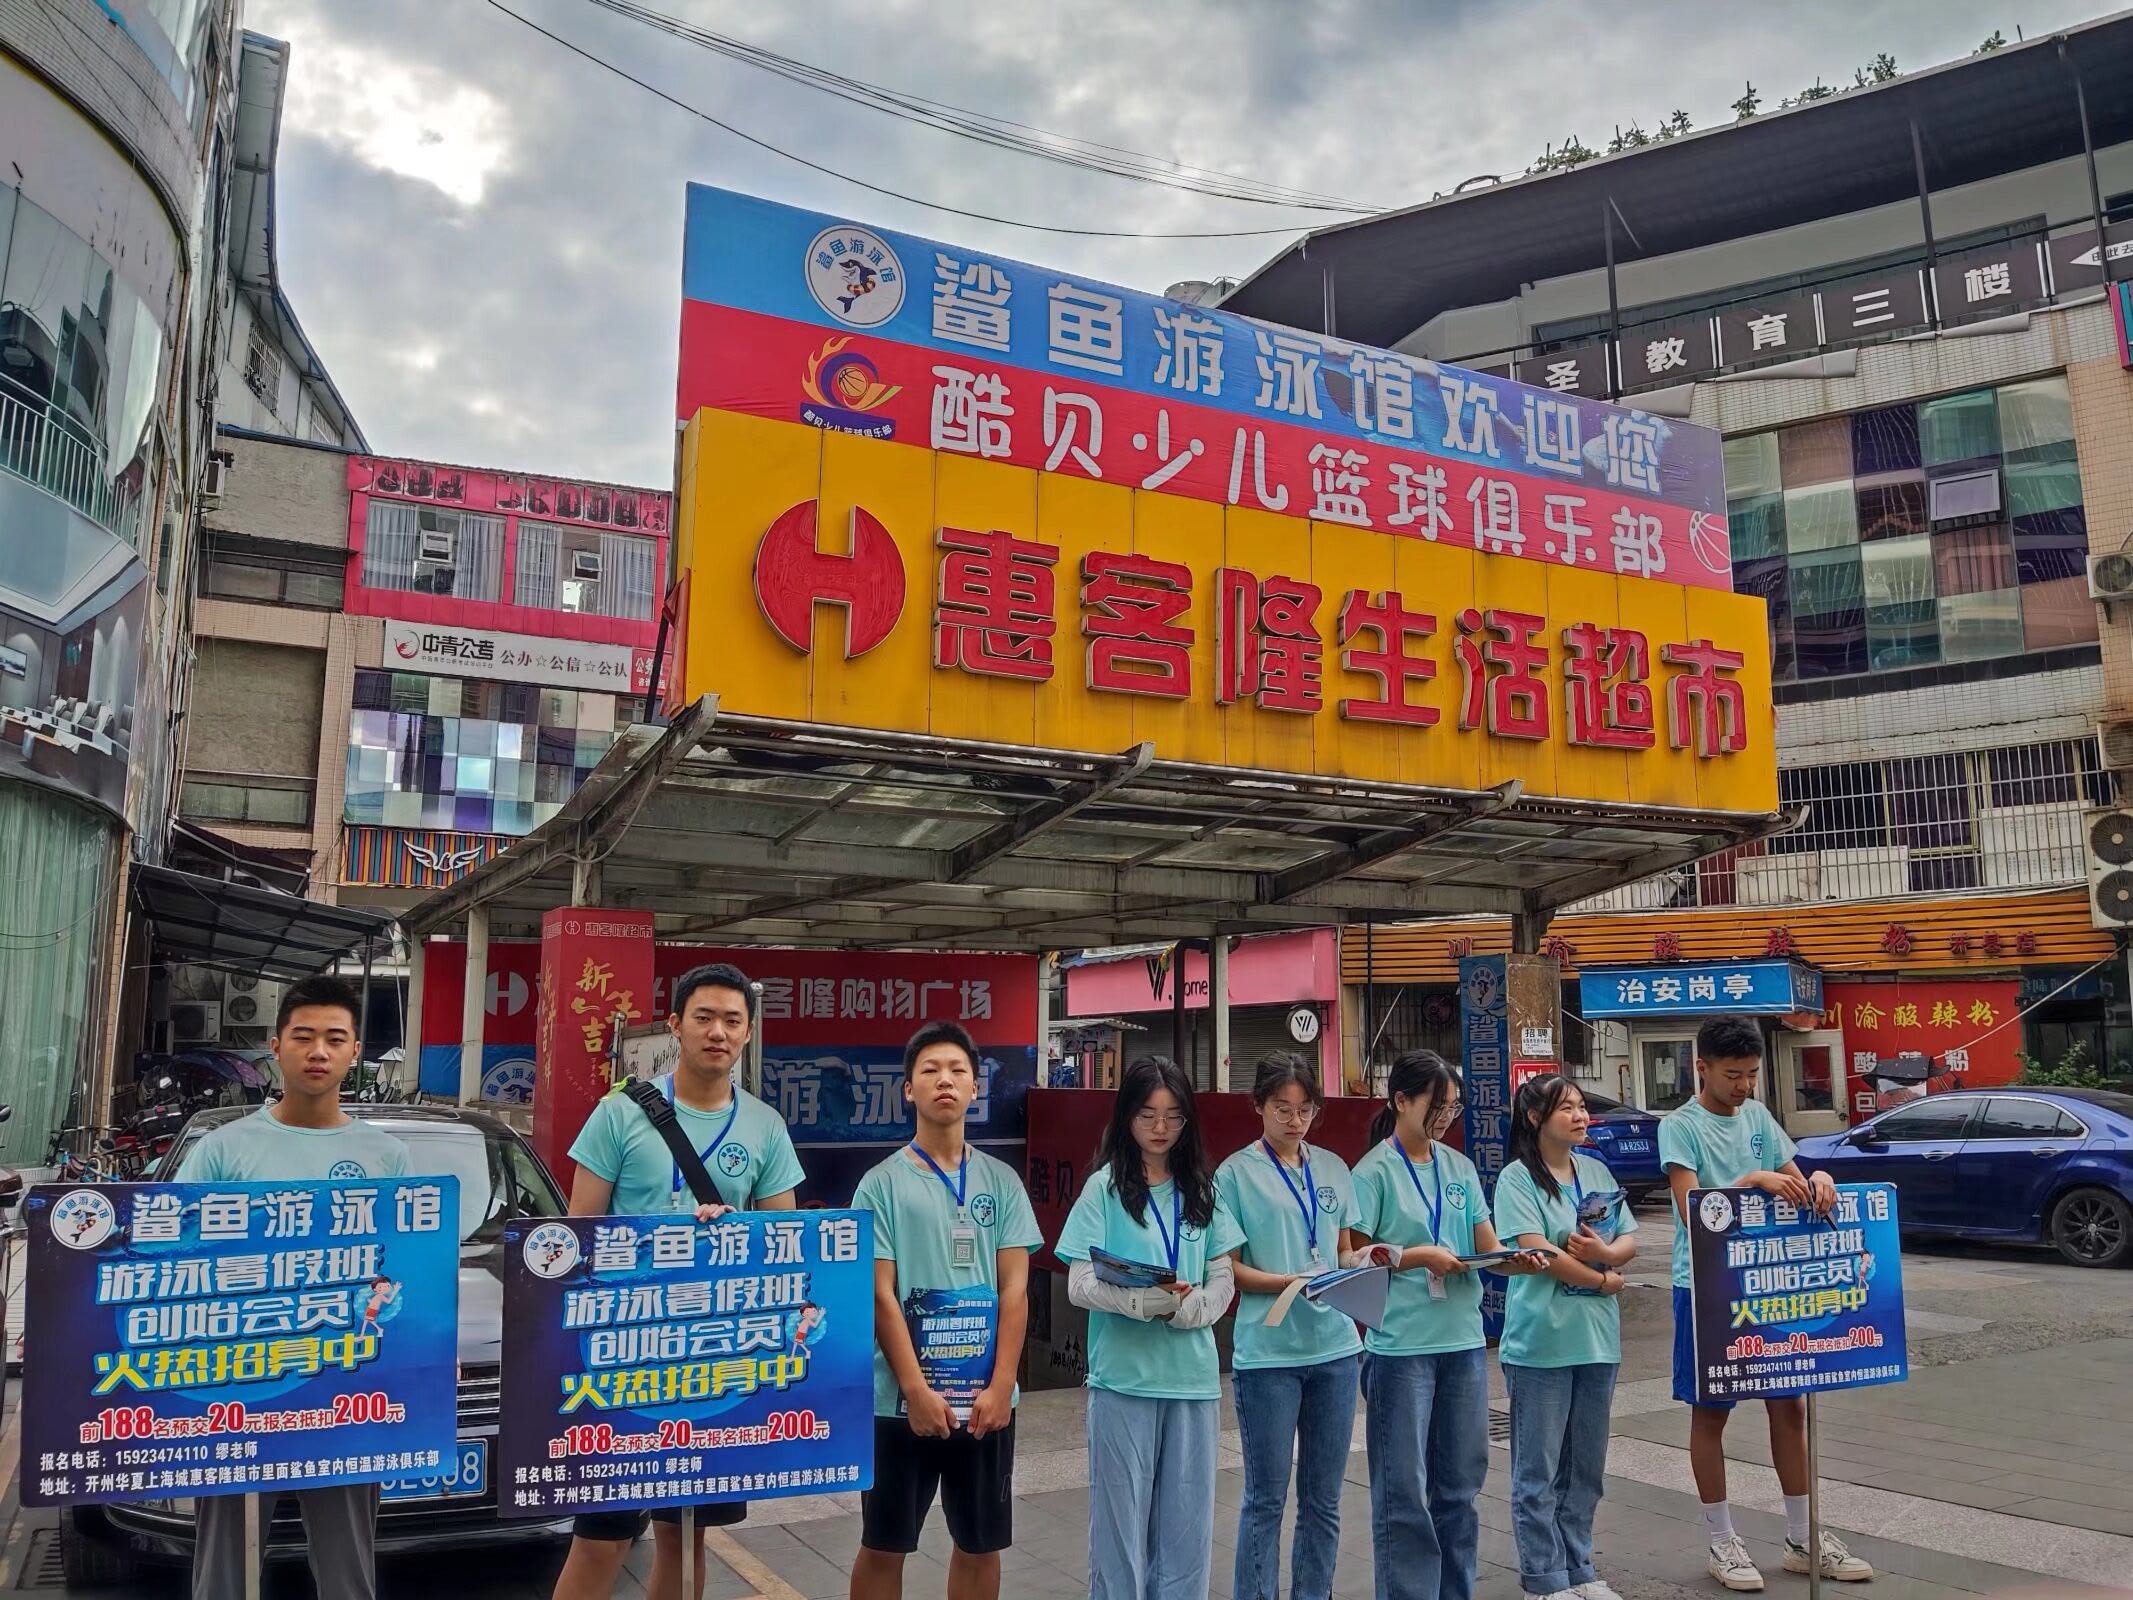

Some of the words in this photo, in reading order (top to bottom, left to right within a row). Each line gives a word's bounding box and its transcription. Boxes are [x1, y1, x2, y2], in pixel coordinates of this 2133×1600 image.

[816, 239, 896, 283] 鲨鱼游泳馆
[932, 252, 1663, 496] 鲨鱼游泳馆欢迎您
[931, 365, 1667, 579] 酷贝少儿篮球俱乐部
[422, 633, 494, 660] 中青公考
[933, 526, 1748, 759] 惠客隆生活超市
[1183, 979, 1208, 997] ome
[1616, 972, 1754, 1004] 治安岗亭
[1854, 1049, 1969, 1073] 酸粉
[131, 1184, 441, 1243] 鲨鱼游泳馆
[593, 1218, 858, 1272] 鲨鱼游泳馆
[1728, 1228, 1864, 1268] 游泳暑假班
[99, 1244, 379, 1302] 游泳暑假班
[1744, 1259, 1853, 1293] 创始会员
[127, 1290, 349, 1344] 创始会员
[565, 1273, 807, 1328] 游泳暑假班
[1730, 1287, 1868, 1328] 火热招募中
[94, 1334, 376, 1394] 火热招募中
[590, 1314, 781, 1366] 创始会员
[559, 1354, 805, 1414] 火热招募中
